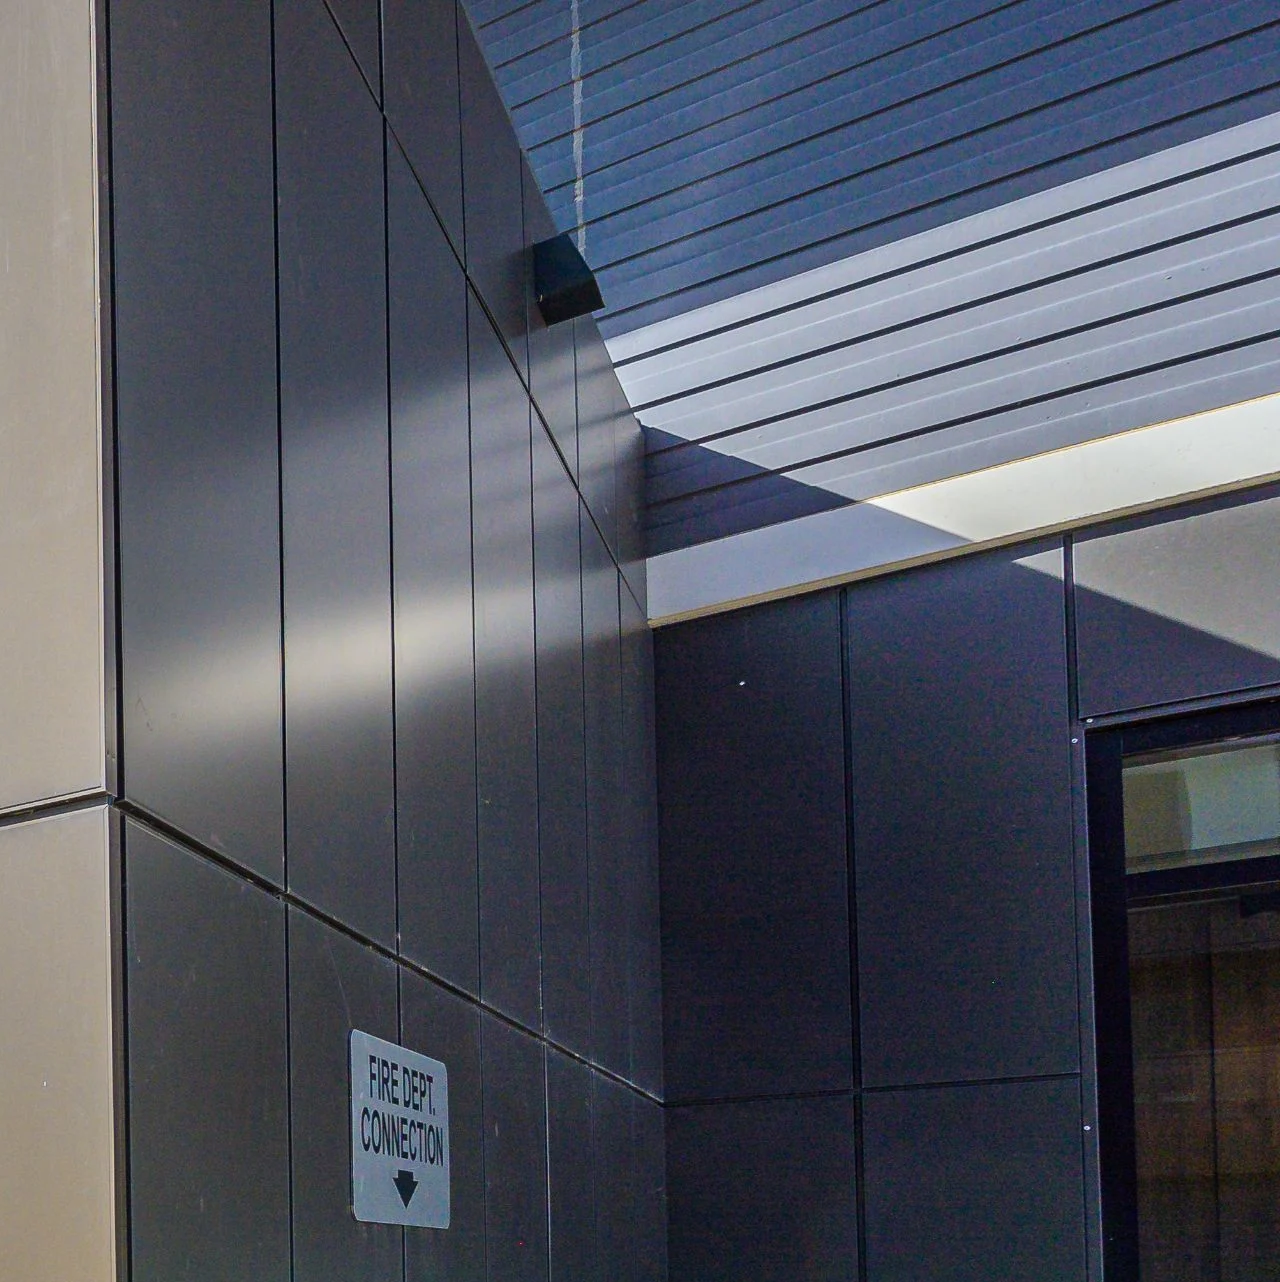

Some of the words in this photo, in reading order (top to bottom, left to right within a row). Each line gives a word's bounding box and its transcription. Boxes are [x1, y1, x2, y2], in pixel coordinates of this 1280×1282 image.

[369, 1055, 399, 1104] FIRE
[402, 1066, 435, 1115] DEPT.
[361, 1107, 444, 1166] CONNECTION
